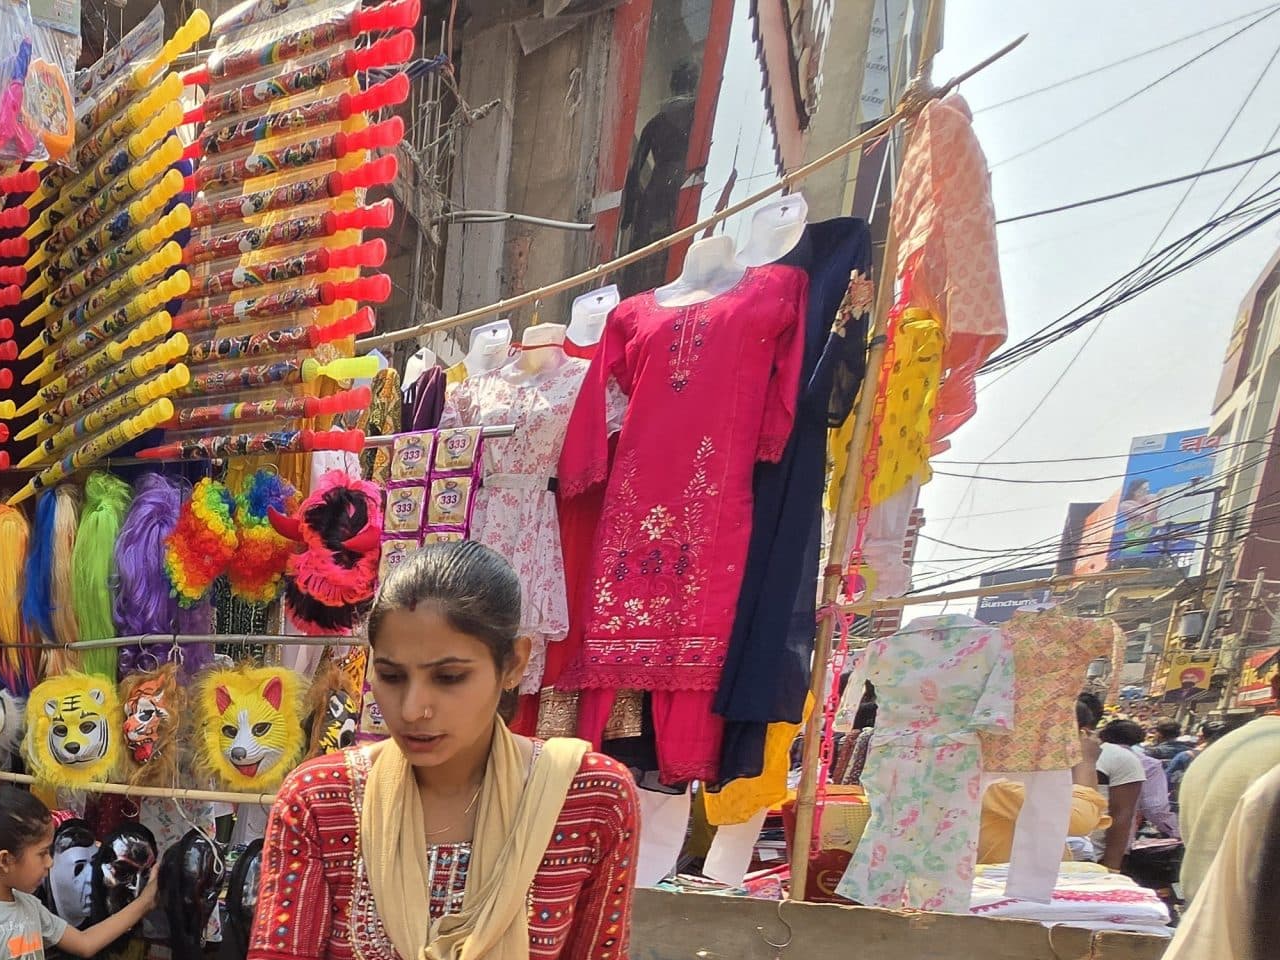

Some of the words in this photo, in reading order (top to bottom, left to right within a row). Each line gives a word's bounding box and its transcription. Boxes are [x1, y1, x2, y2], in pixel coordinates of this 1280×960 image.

[448, 439, 467, 450] 333
[403, 450, 421, 461] 333
[440, 494, 458, 505] 333
[395, 503, 412, 514] 333
